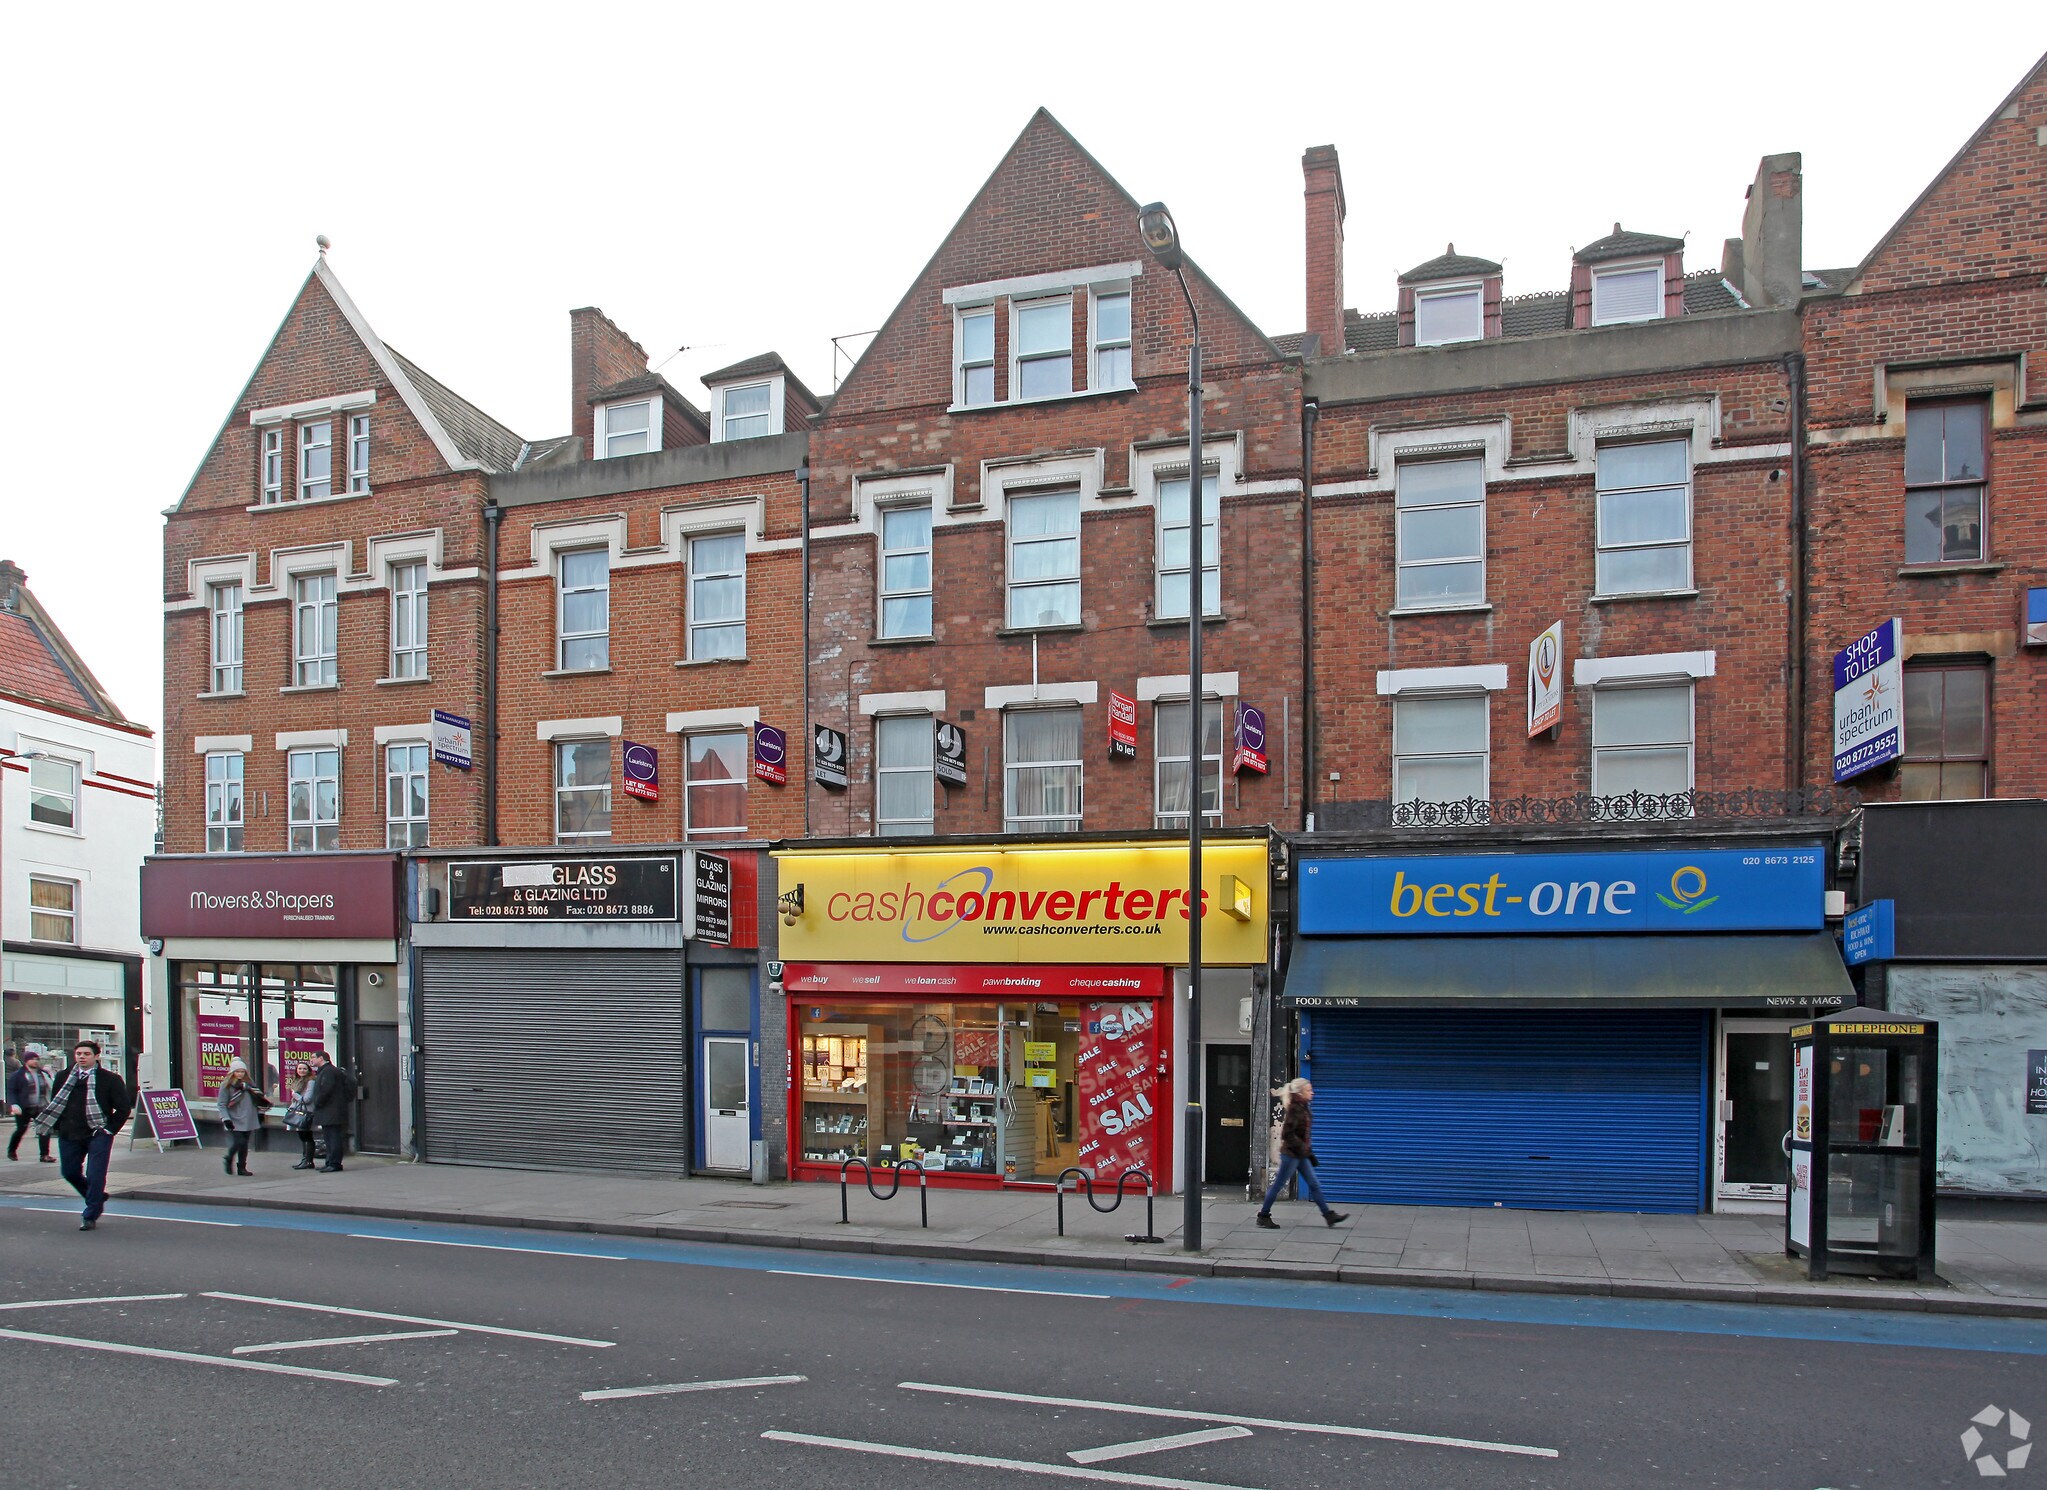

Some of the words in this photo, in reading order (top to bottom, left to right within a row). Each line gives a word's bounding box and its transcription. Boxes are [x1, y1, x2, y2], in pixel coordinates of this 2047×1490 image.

[1846, 631, 1878, 663] SHOP
[1844, 663, 1858, 682] TO
[1862, 646, 1882, 673] LET
[1112, 696, 1133, 713] Morgan
[1839, 704, 1871, 730] urban
[1839, 707, 1893, 746] spectrum
[437, 736, 457, 746] urban
[759, 739, 781, 751] Lauristons
[437, 742, 469, 754] spectrum
[1116, 742, 1123, 752] to
[1124, 745, 1135, 756] let
[1243, 749, 1251, 757] LET
[1836, 755, 1851, 770] 020
[1852, 745, 1873, 763] 8772
[1874, 733, 1896, 754] 9552
[628, 757, 653, 769] Lauristons
[756, 762, 766, 770] LET
[816, 770, 826, 778] LET
[938, 766, 952, 775] SOLD
[700, 859, 723, 873] GLASS
[1743, 857, 1760, 865] 020
[1765, 857, 1788, 865] 8673
[1793, 856, 1814, 864] 2125
[454, 869, 463, 877] 65
[552, 866, 617, 885] GLASS
[709, 871, 715, 880] &
[696, 878, 727, 893] GLAZING
[513, 890, 522, 901] &
[525, 889, 580, 901] GLAZING
[584, 888, 607, 900] LTD
[1390, 872, 1636, 917] best-one
[696, 894, 727, 908] MIRRORS
[469, 906, 485, 916] Tel:
[486, 906, 502, 915] 020
[503, 906, 525, 915] 8673
[527, 906, 549, 915] 5006
[566, 905, 586, 915] Fax:
[587, 905, 604, 915] 020
[606, 905, 628, 915] 8673
[631, 905, 654, 915] 8886
[697, 914, 705, 922] 020
[983, 923, 1161, 935] www.cashconverters.co.uk
[1848, 941, 1859, 952] FOOD
[1855, 949, 1867, 960] OPEN
[983, 977, 1041, 987] pawnbroking
[1069, 978, 1101, 988] cheque
[1102, 978, 1141, 988] cashing
[1296, 997, 1321, 1006] FOOD
[1325, 998, 1332, 1006] &
[1336, 998, 1358, 1006] WINE
[1767, 997, 1795, 1005] NEWS
[1799, 997, 1807, 1005] &
[1812, 997, 1842, 1005] MAGS
[1100, 1002, 1153, 1040] SAL
[1836, 1024, 1917, 1033] TELEPHONE
[202, 1042, 235, 1053] BRAND
[956, 1037, 987, 1060] SALE
[1128, 1041, 1144, 1053] SALE
[202, 1053, 235, 1066] NEW
[284, 1051, 312, 1060] DOUBL
[1079, 1046, 1101, 1064] SALE
[1098, 1060, 1118, 1075] SALE
[1126, 1064, 1146, 1079] SALE
[1090, 1088, 1115, 1106] SALE
[153, 1101, 179, 1110] NEW
[1100, 1093, 1153, 1136] SAL
[1127, 1136, 1144, 1149] SALE
[1097, 1155, 1117, 1169] SALE
